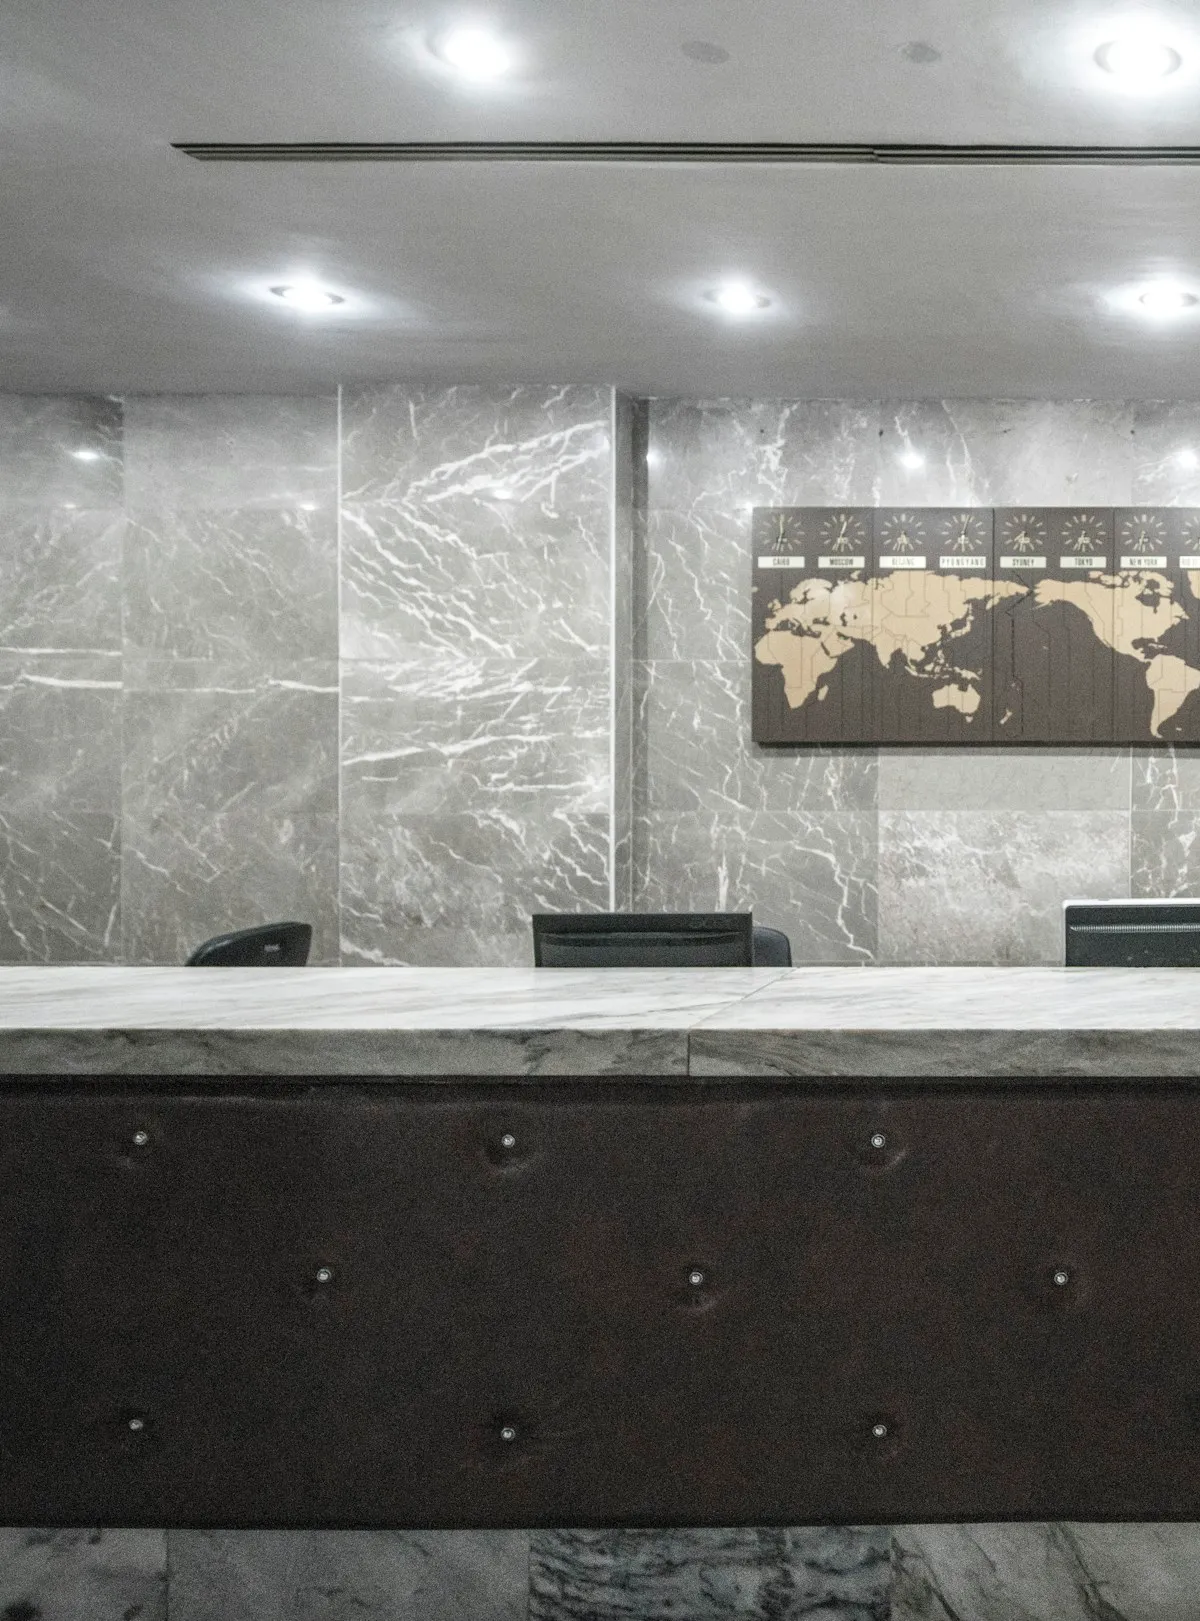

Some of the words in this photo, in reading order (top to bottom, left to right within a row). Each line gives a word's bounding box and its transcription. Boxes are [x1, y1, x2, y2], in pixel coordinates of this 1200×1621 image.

[772, 558, 790, 566] CAIRO
[829, 558, 854, 566] MOSCOW
[941, 558, 985, 566] PYONGYANG
[1012, 558, 1035, 566] SYDNEY
[1074, 558, 1093, 566] TOKYO
[1129, 558, 1142, 566] NEW
[1144, 558, 1158, 566] YORK
